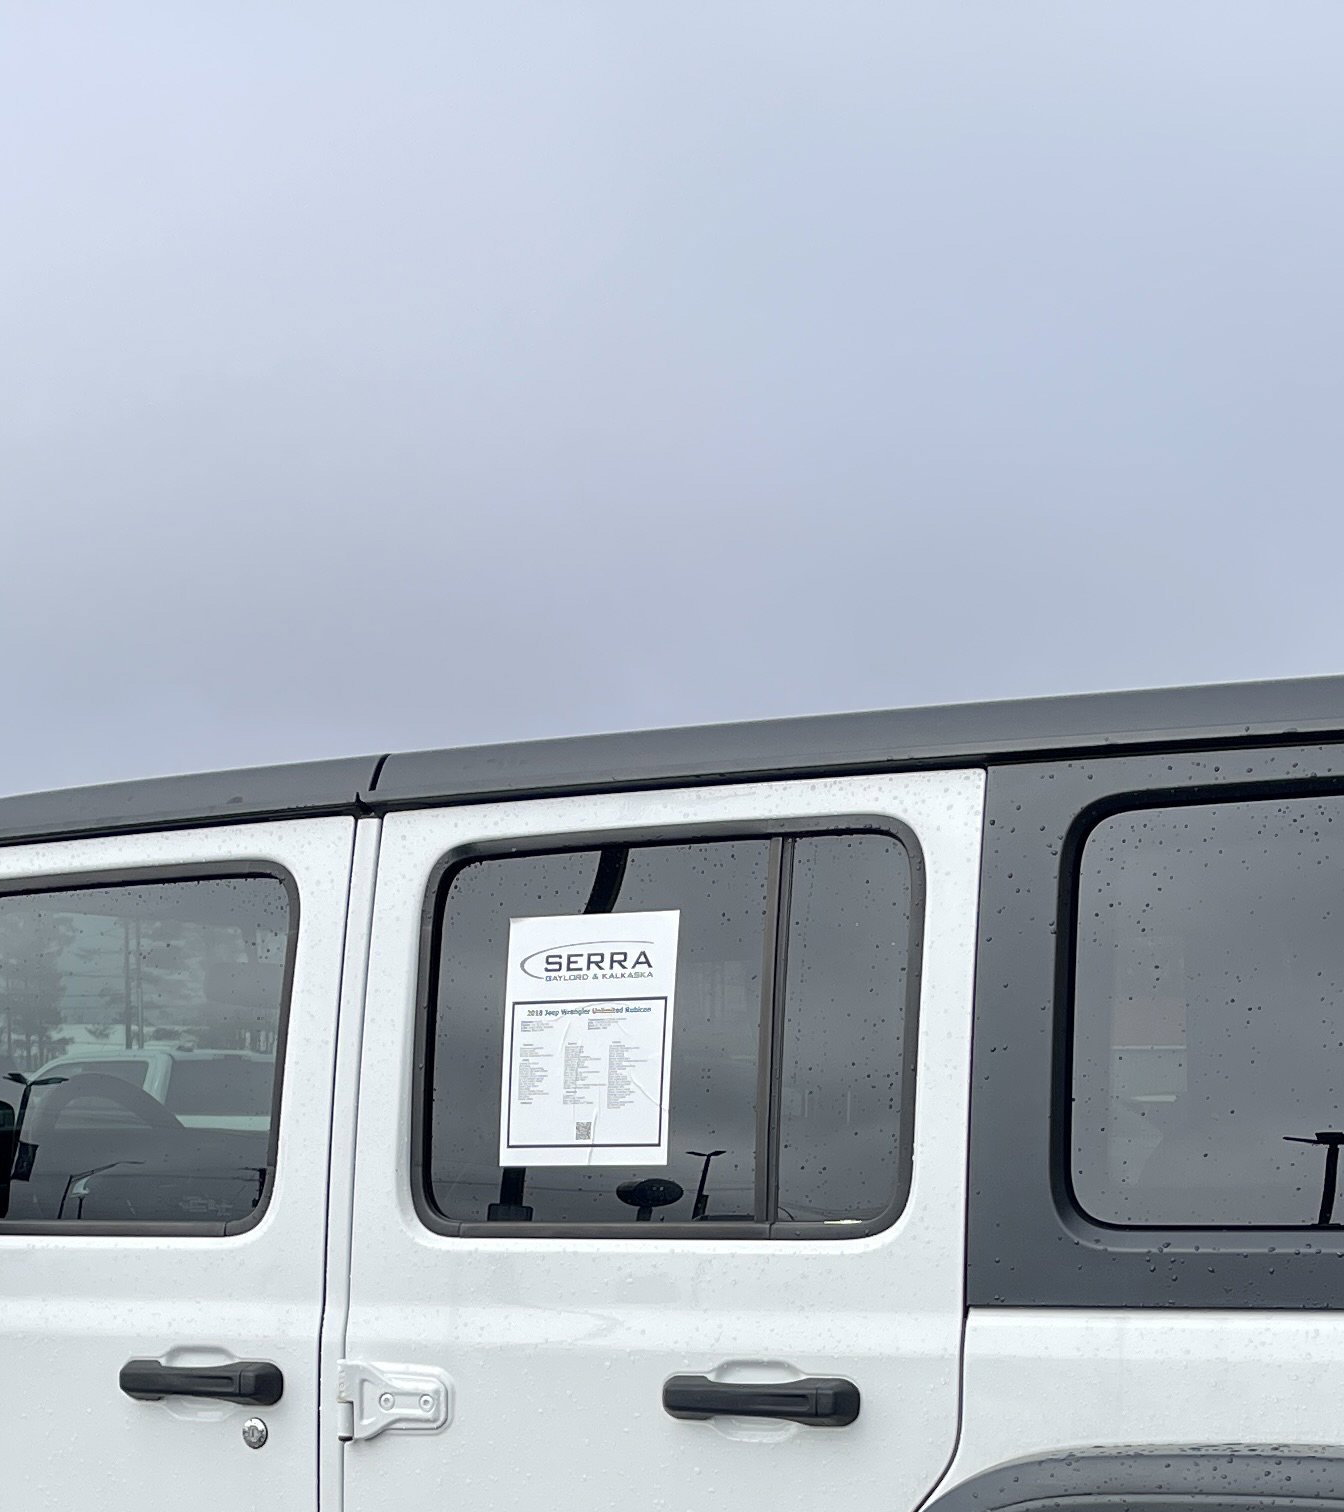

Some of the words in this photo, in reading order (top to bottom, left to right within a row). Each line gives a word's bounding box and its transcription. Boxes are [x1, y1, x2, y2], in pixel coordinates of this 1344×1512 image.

[543, 950, 654, 973] SERRA
[545, 973, 589, 982] GAYLORD
[601, 971, 654, 980] KALKASKA
[544, 1009, 560, 1018] Jeep
[560, 1007, 590, 1017] Wrangler
[625, 1006, 652, 1014] Rubicon
